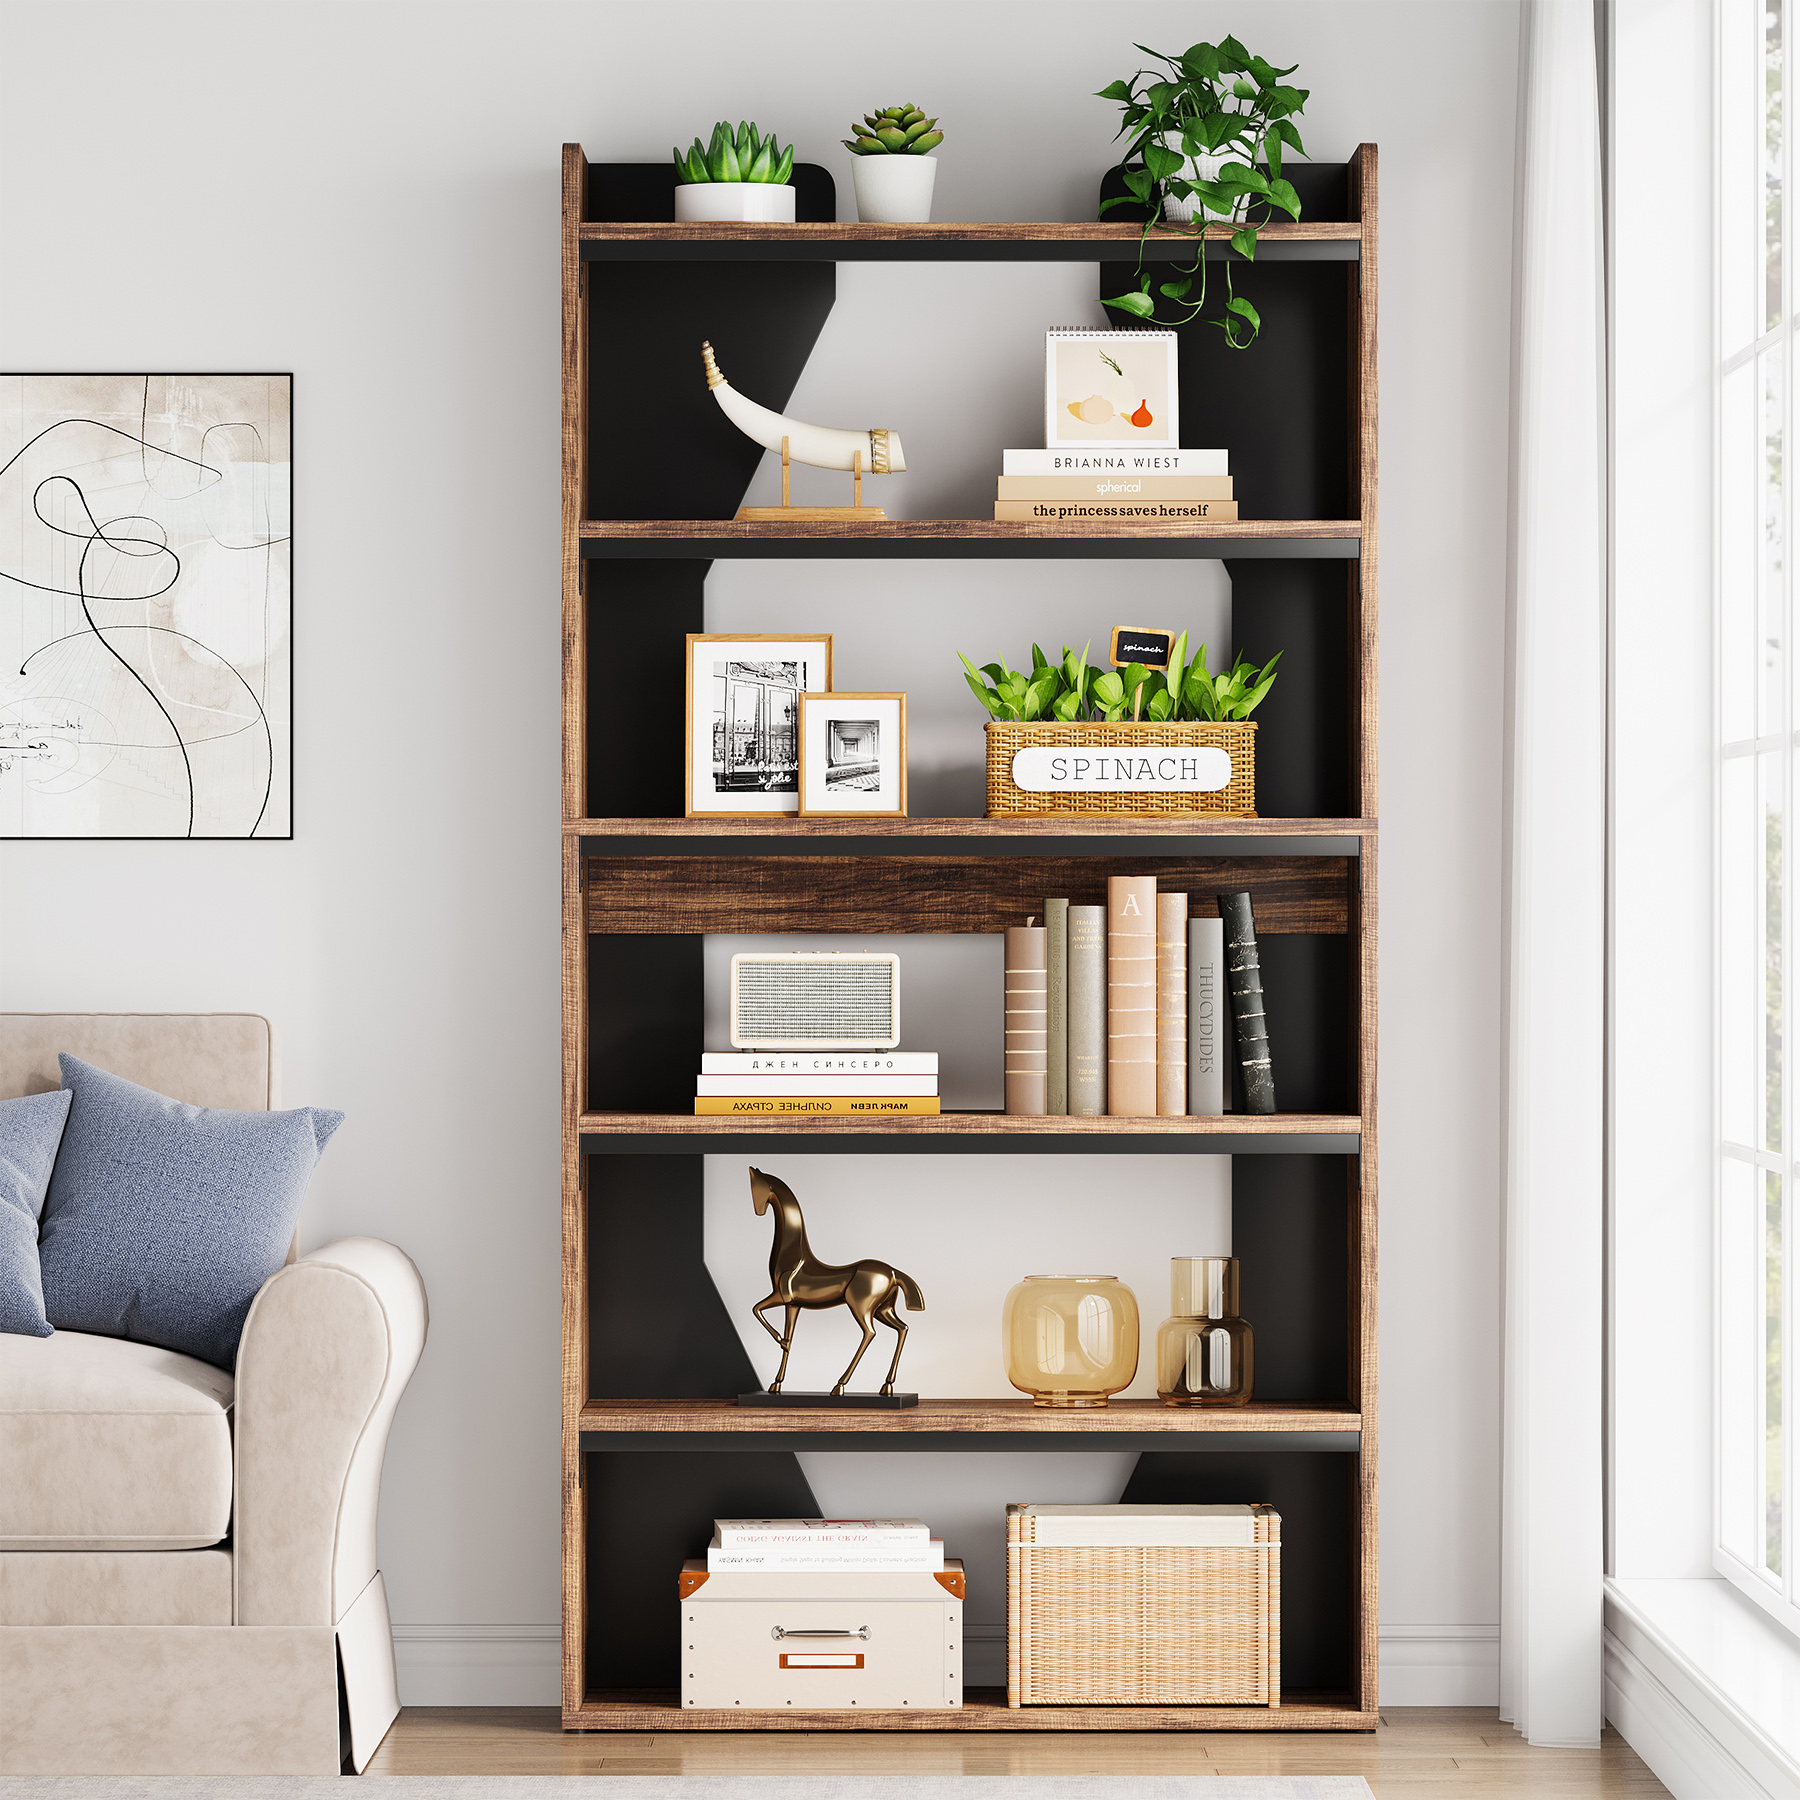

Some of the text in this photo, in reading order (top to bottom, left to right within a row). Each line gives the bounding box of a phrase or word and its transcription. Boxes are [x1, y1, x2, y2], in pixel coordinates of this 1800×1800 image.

[1054, 457, 1180, 468] BRIANNA WIEST
[1096, 479, 1141, 495] spherical
[1033, 504, 1209, 519] the princess saves herself
[1122, 643, 1165, 654] spinach
[1051, 758, 1198, 781] SPINACH
[764, 772, 792, 791] jolie
[1120, 893, 1143, 916] A
[1051, 976, 1062, 1032] Revolution
[1197, 962, 1215, 1074] THUCYDIDES
[752, 1060, 893, 1069] ДЖЕН СИНСЕРО
